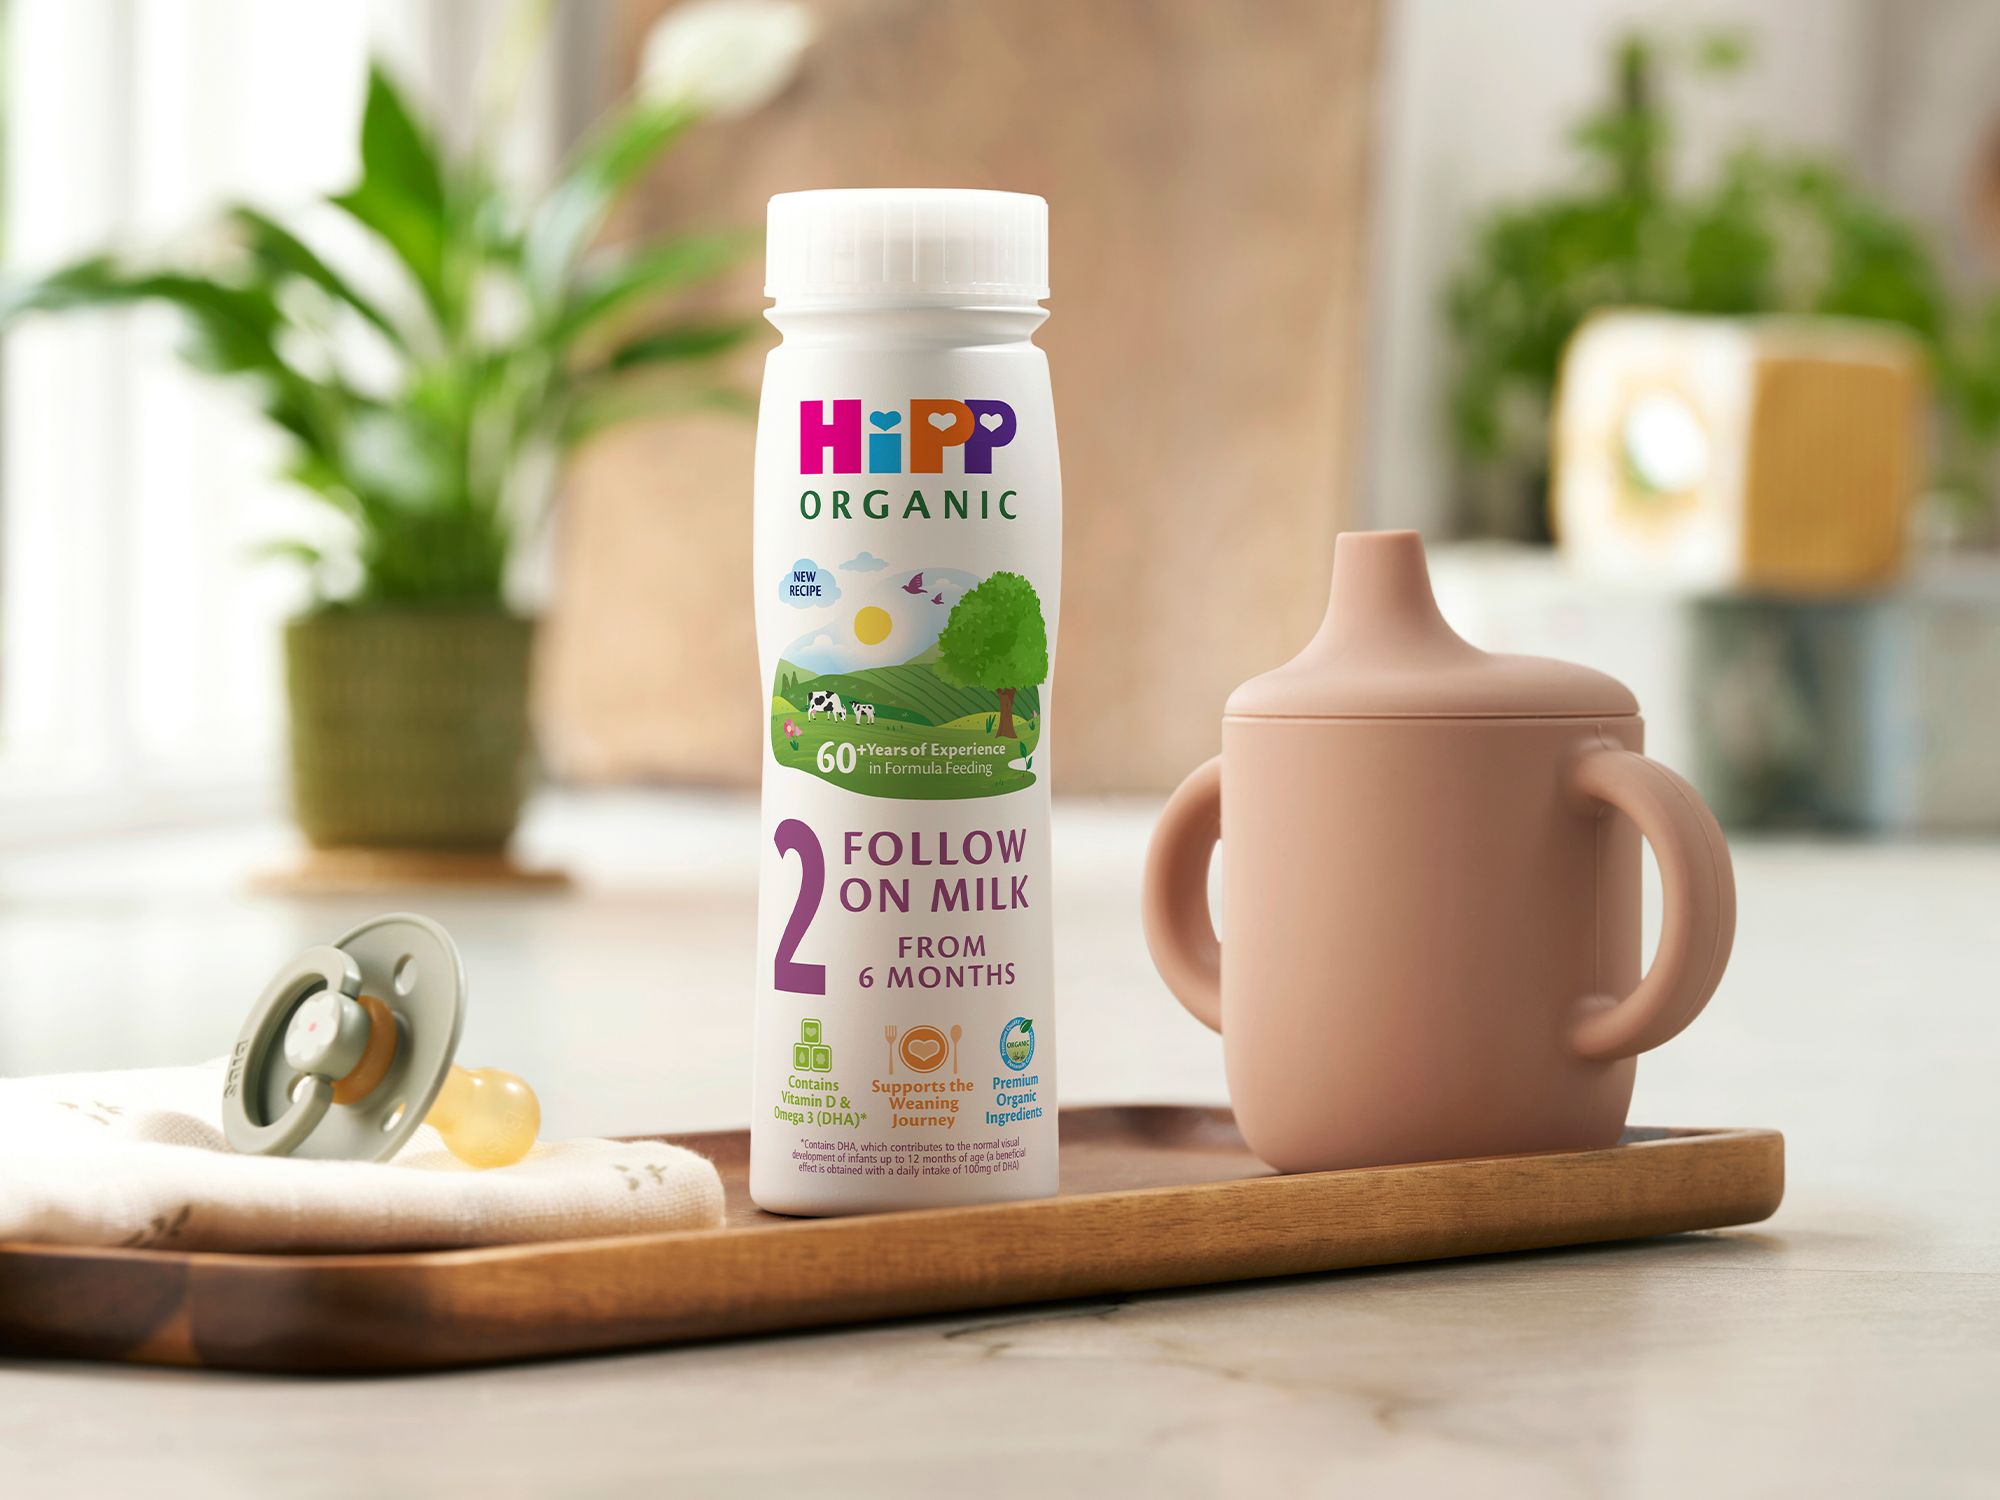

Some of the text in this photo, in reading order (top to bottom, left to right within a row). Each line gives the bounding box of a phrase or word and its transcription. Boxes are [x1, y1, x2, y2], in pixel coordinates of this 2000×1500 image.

[800, 399, 1017, 474] HiPP
[800, 489, 1017, 519] ORGANIC
[793, 571, 816, 583] NEW
[789, 585, 821, 597] RECIPE
[866, 743, 906, 756] Years
[910, 743, 927, 756] of
[931, 743, 1005, 759] Experience
[869, 761, 992, 776] in Formula Feeding
[844, 828, 1027, 866] FOLLOW
[839, 874, 1029, 913] ON MILK
[774, 818, 826, 995] 2
[898, 935, 986, 958] FROM
[858, 962, 1016, 988] 6 MONTHS
[788, 1074, 839, 1091] Contains
[872, 1078, 974, 1096] Supports the
[993, 1073, 1039, 1090] Premium
[781, 1090, 851, 1109] Vitamin D &
[889, 1096, 959, 1113] Weaning
[996, 1089, 1036, 1108] Organic
[774, 1105, 804, 1126] Omega
[807, 1111, 814, 1123] 3
[892, 1114, 955, 1129] Journey
[986, 1107, 1042, 1126] Ingredients
[837, 1141, 858, 1152] DHA,
[861, 1142, 887, 1152] which
[890, 1142, 942, 1152] contributes
[945, 1143, 954, 1151] to
[957, 1141, 971, 1151] the
[973, 1139, 999, 1150] normal
[1001, 1136, 1020, 1148] visual
[792, 1147, 1026, 1165] development of infants up to 12 months of age (a beneficial
[798, 1160, 1019, 1178] effect is obtained with a daily intake of 100mg of DHA)
